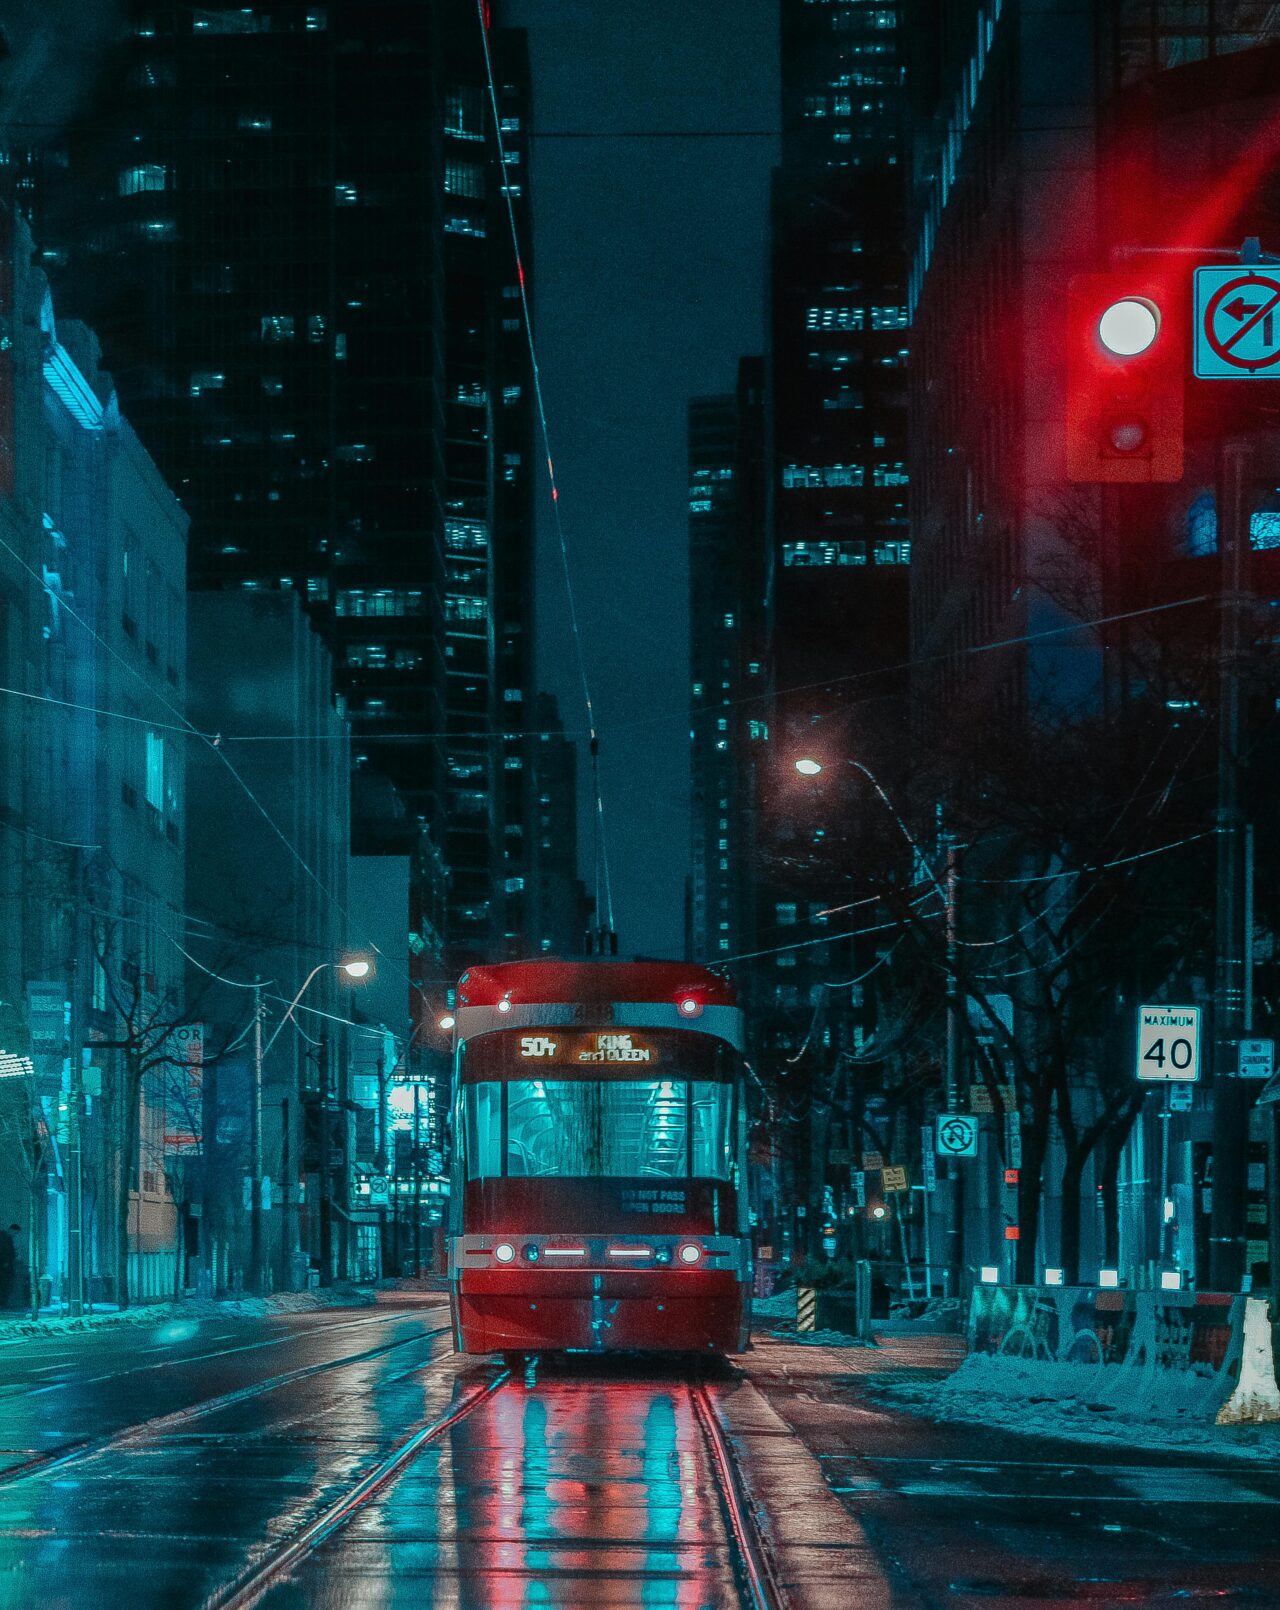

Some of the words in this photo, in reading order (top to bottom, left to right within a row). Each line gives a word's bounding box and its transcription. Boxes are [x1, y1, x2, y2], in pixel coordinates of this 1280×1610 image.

[1144, 1015, 1193, 1026] MAXIMUM
[521, 1037, 557, 1056] 504
[597, 1034, 632, 1049] KING
[579, 1050, 604, 1061] and
[607, 1049, 650, 1061] QUEEN
[1144, 1038, 1192, 1069] 40
[638, 1190, 659, 1200] NOT
[660, 1190, 685, 1201] PASS
[652, 1202, 686, 1213] DOORS
